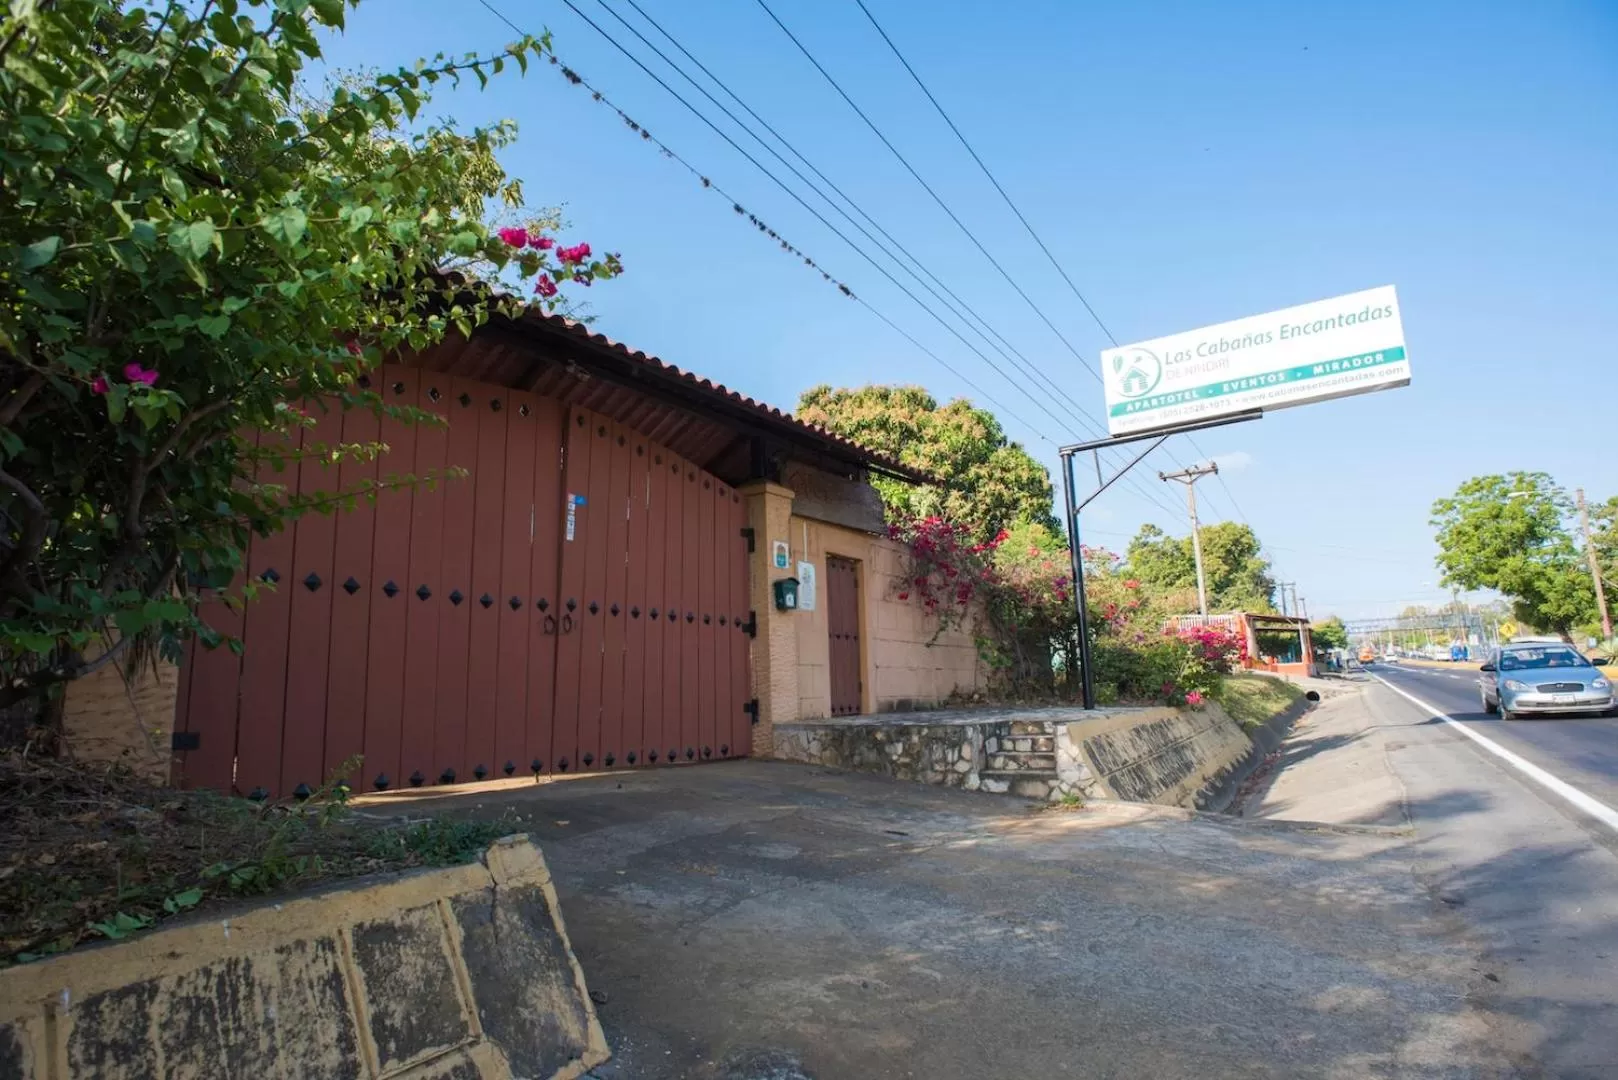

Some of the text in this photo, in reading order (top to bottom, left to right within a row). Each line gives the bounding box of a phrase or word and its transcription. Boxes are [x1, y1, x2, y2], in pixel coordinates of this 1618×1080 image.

[1165, 304, 1393, 365] Las Cabañas Encantadas
[1126, 352, 1385, 412] APARTOTEL EVENTOS MIRADOR
